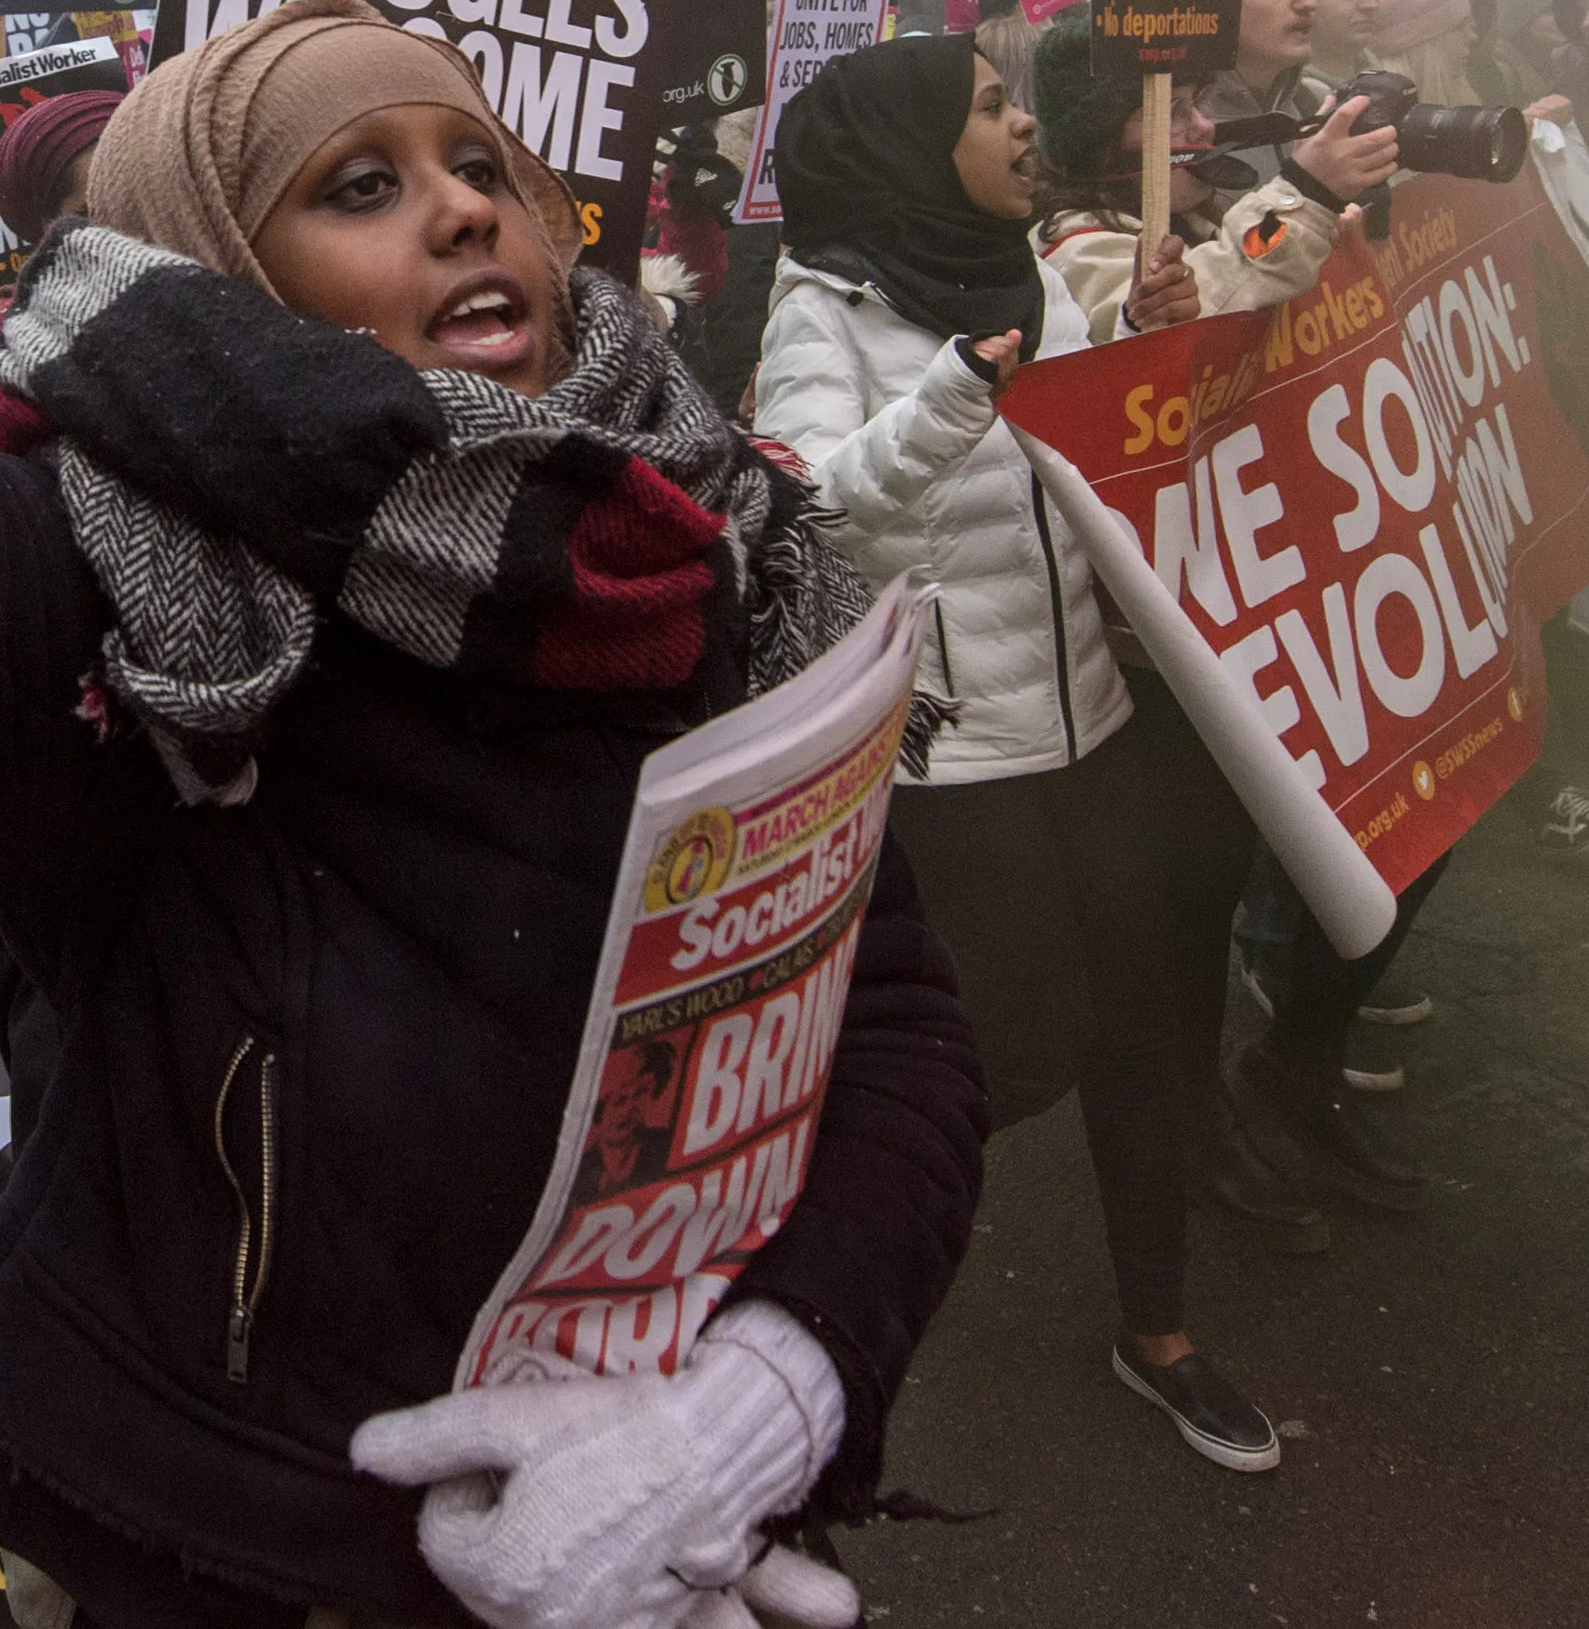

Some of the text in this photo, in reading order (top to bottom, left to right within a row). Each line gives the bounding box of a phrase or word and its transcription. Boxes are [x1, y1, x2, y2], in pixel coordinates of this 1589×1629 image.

[779, 21, 874, 53] JOBS, HOMES
[1103, 5, 1219, 43] No deportations
[779, 60, 790, 88] &
[742, 786, 830, 859] MARCH
[671, 820, 854, 971] Socialist
[544, 1118, 810, 1284] DOWN
